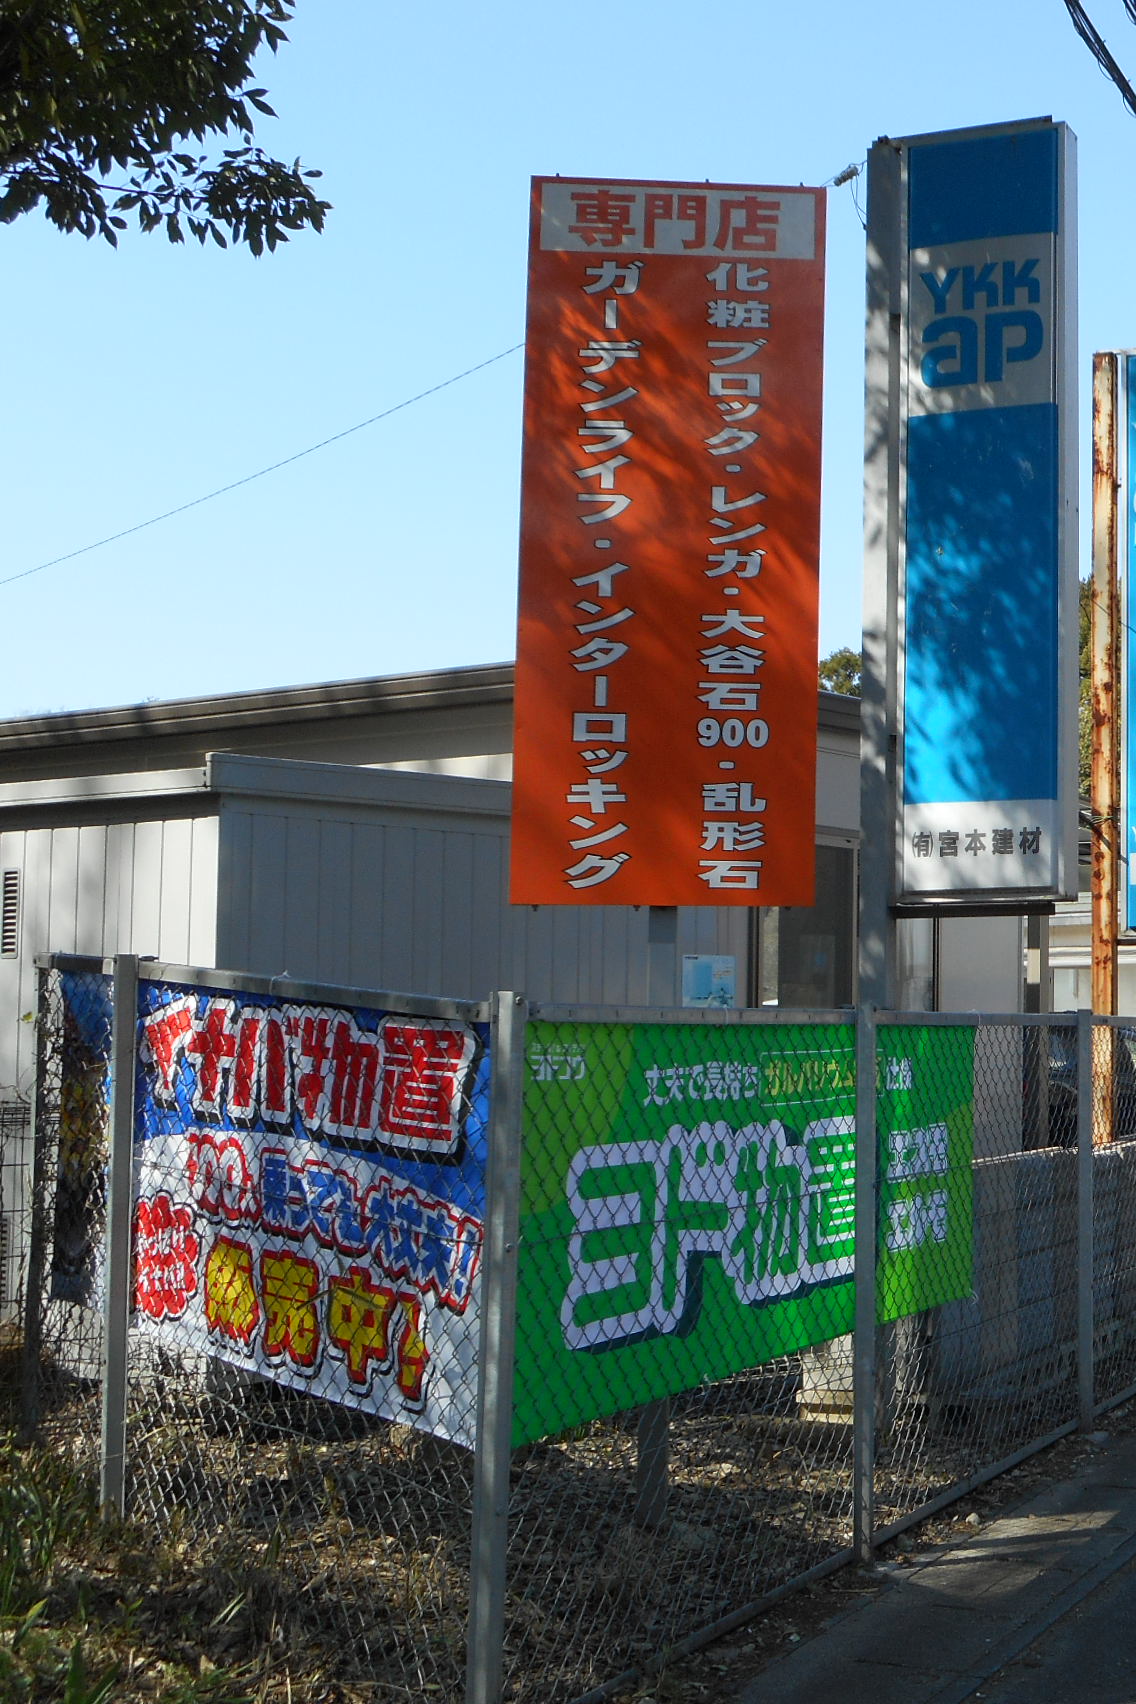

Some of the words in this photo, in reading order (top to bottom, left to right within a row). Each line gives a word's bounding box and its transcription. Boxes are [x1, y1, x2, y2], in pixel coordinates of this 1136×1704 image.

[569, 189, 781, 252] 専門店
[920, 257, 1041, 313] YKK
[144, 1001, 470, 1146] イナバ物置
